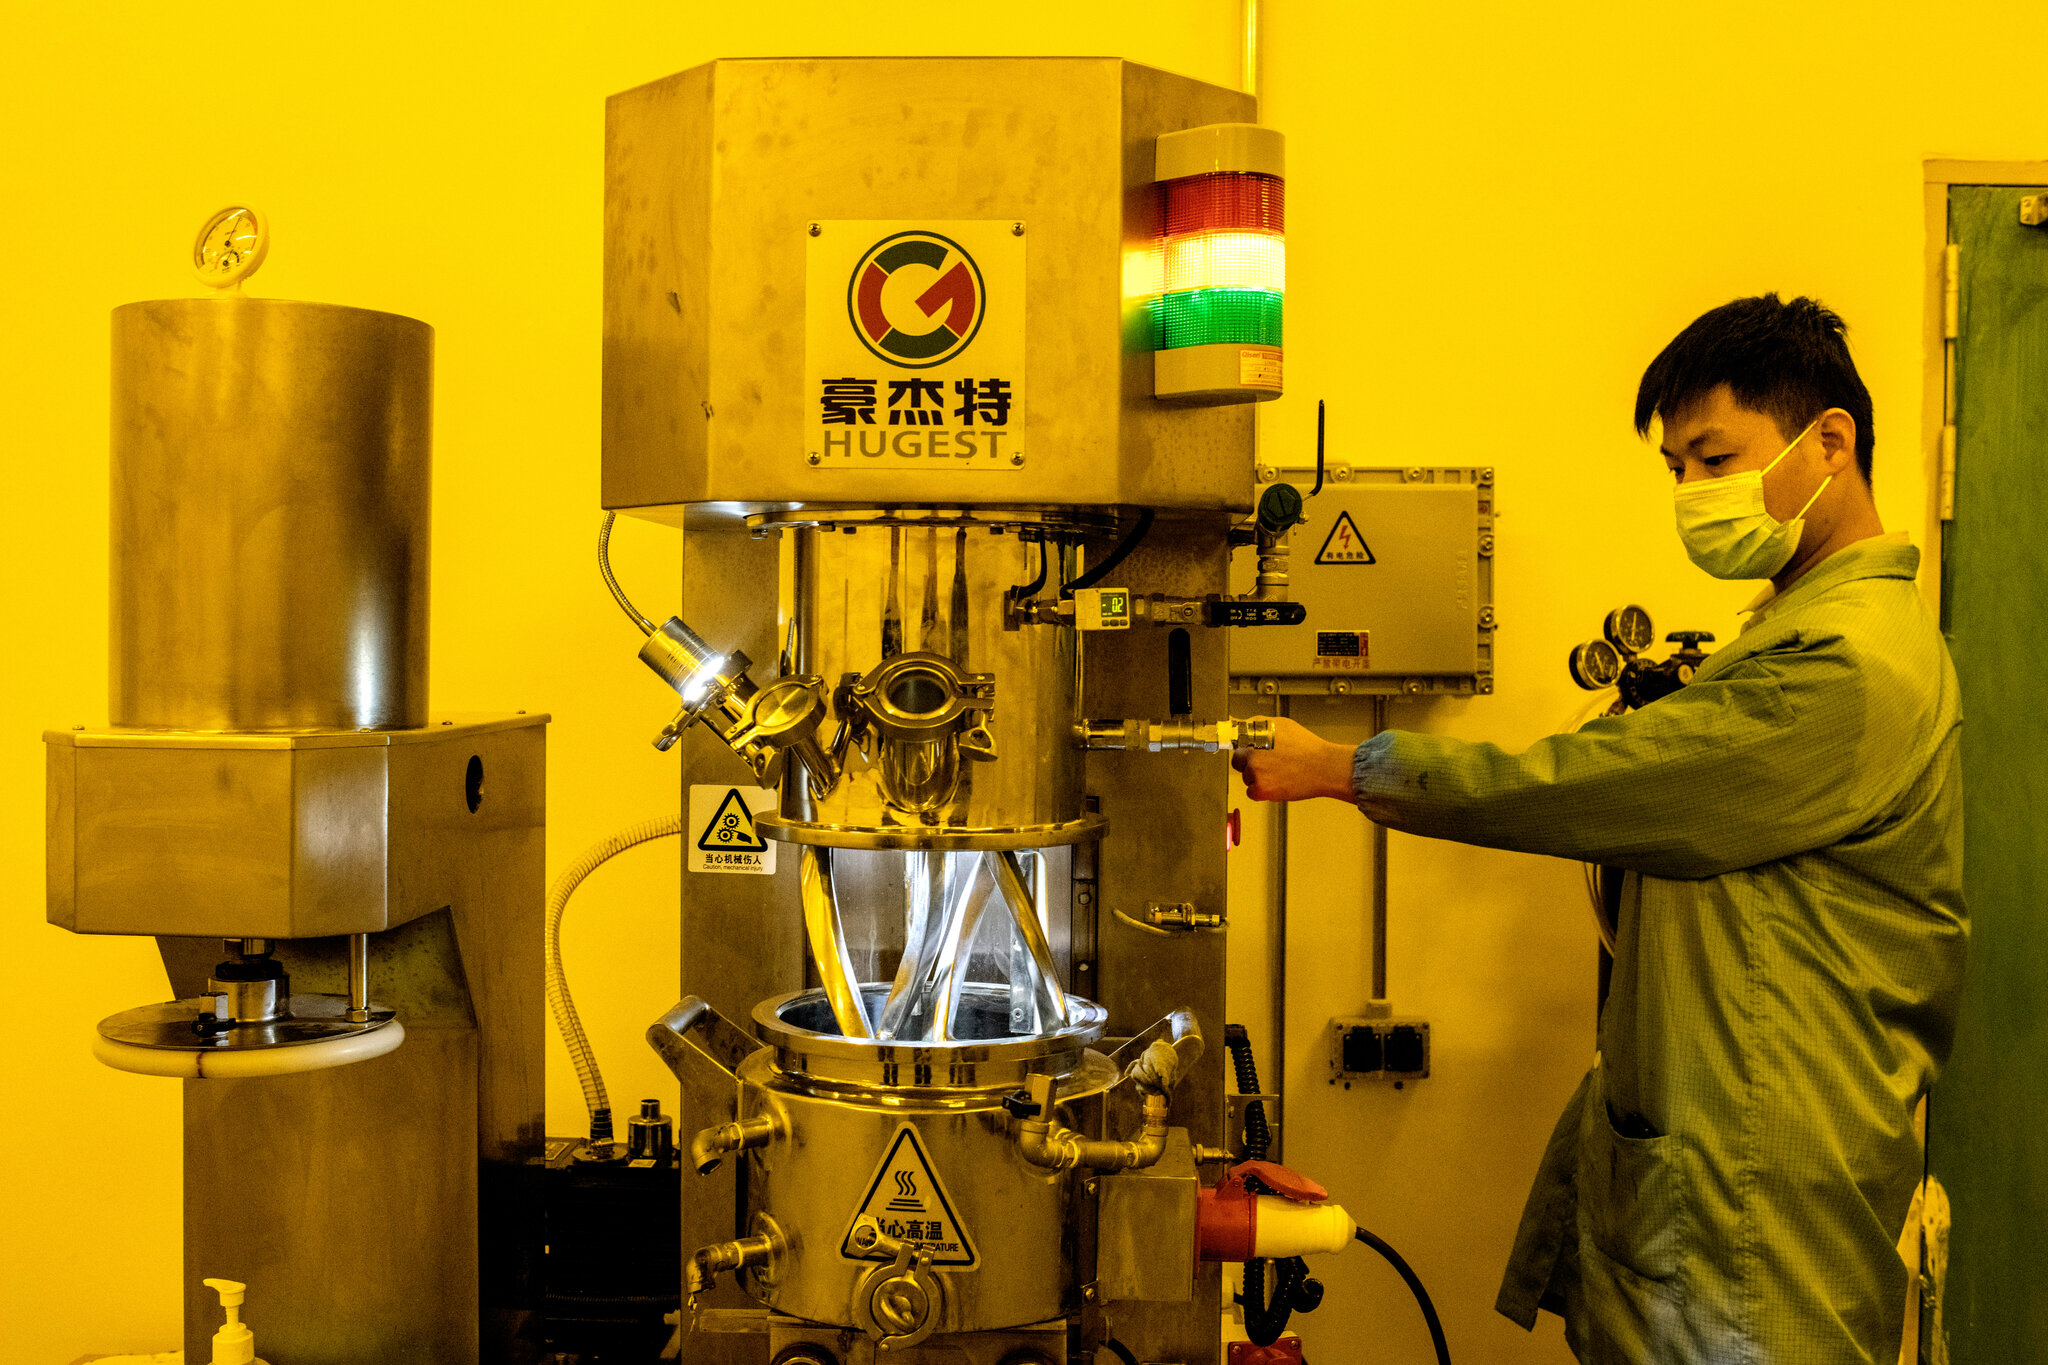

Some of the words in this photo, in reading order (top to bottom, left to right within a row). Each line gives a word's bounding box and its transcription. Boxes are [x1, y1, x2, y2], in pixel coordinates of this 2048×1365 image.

[821, 378, 1012, 426] 豪杰特
[824, 430, 1008, 459] HUGEST
[705, 853, 761, 865] 当心机械伤人
